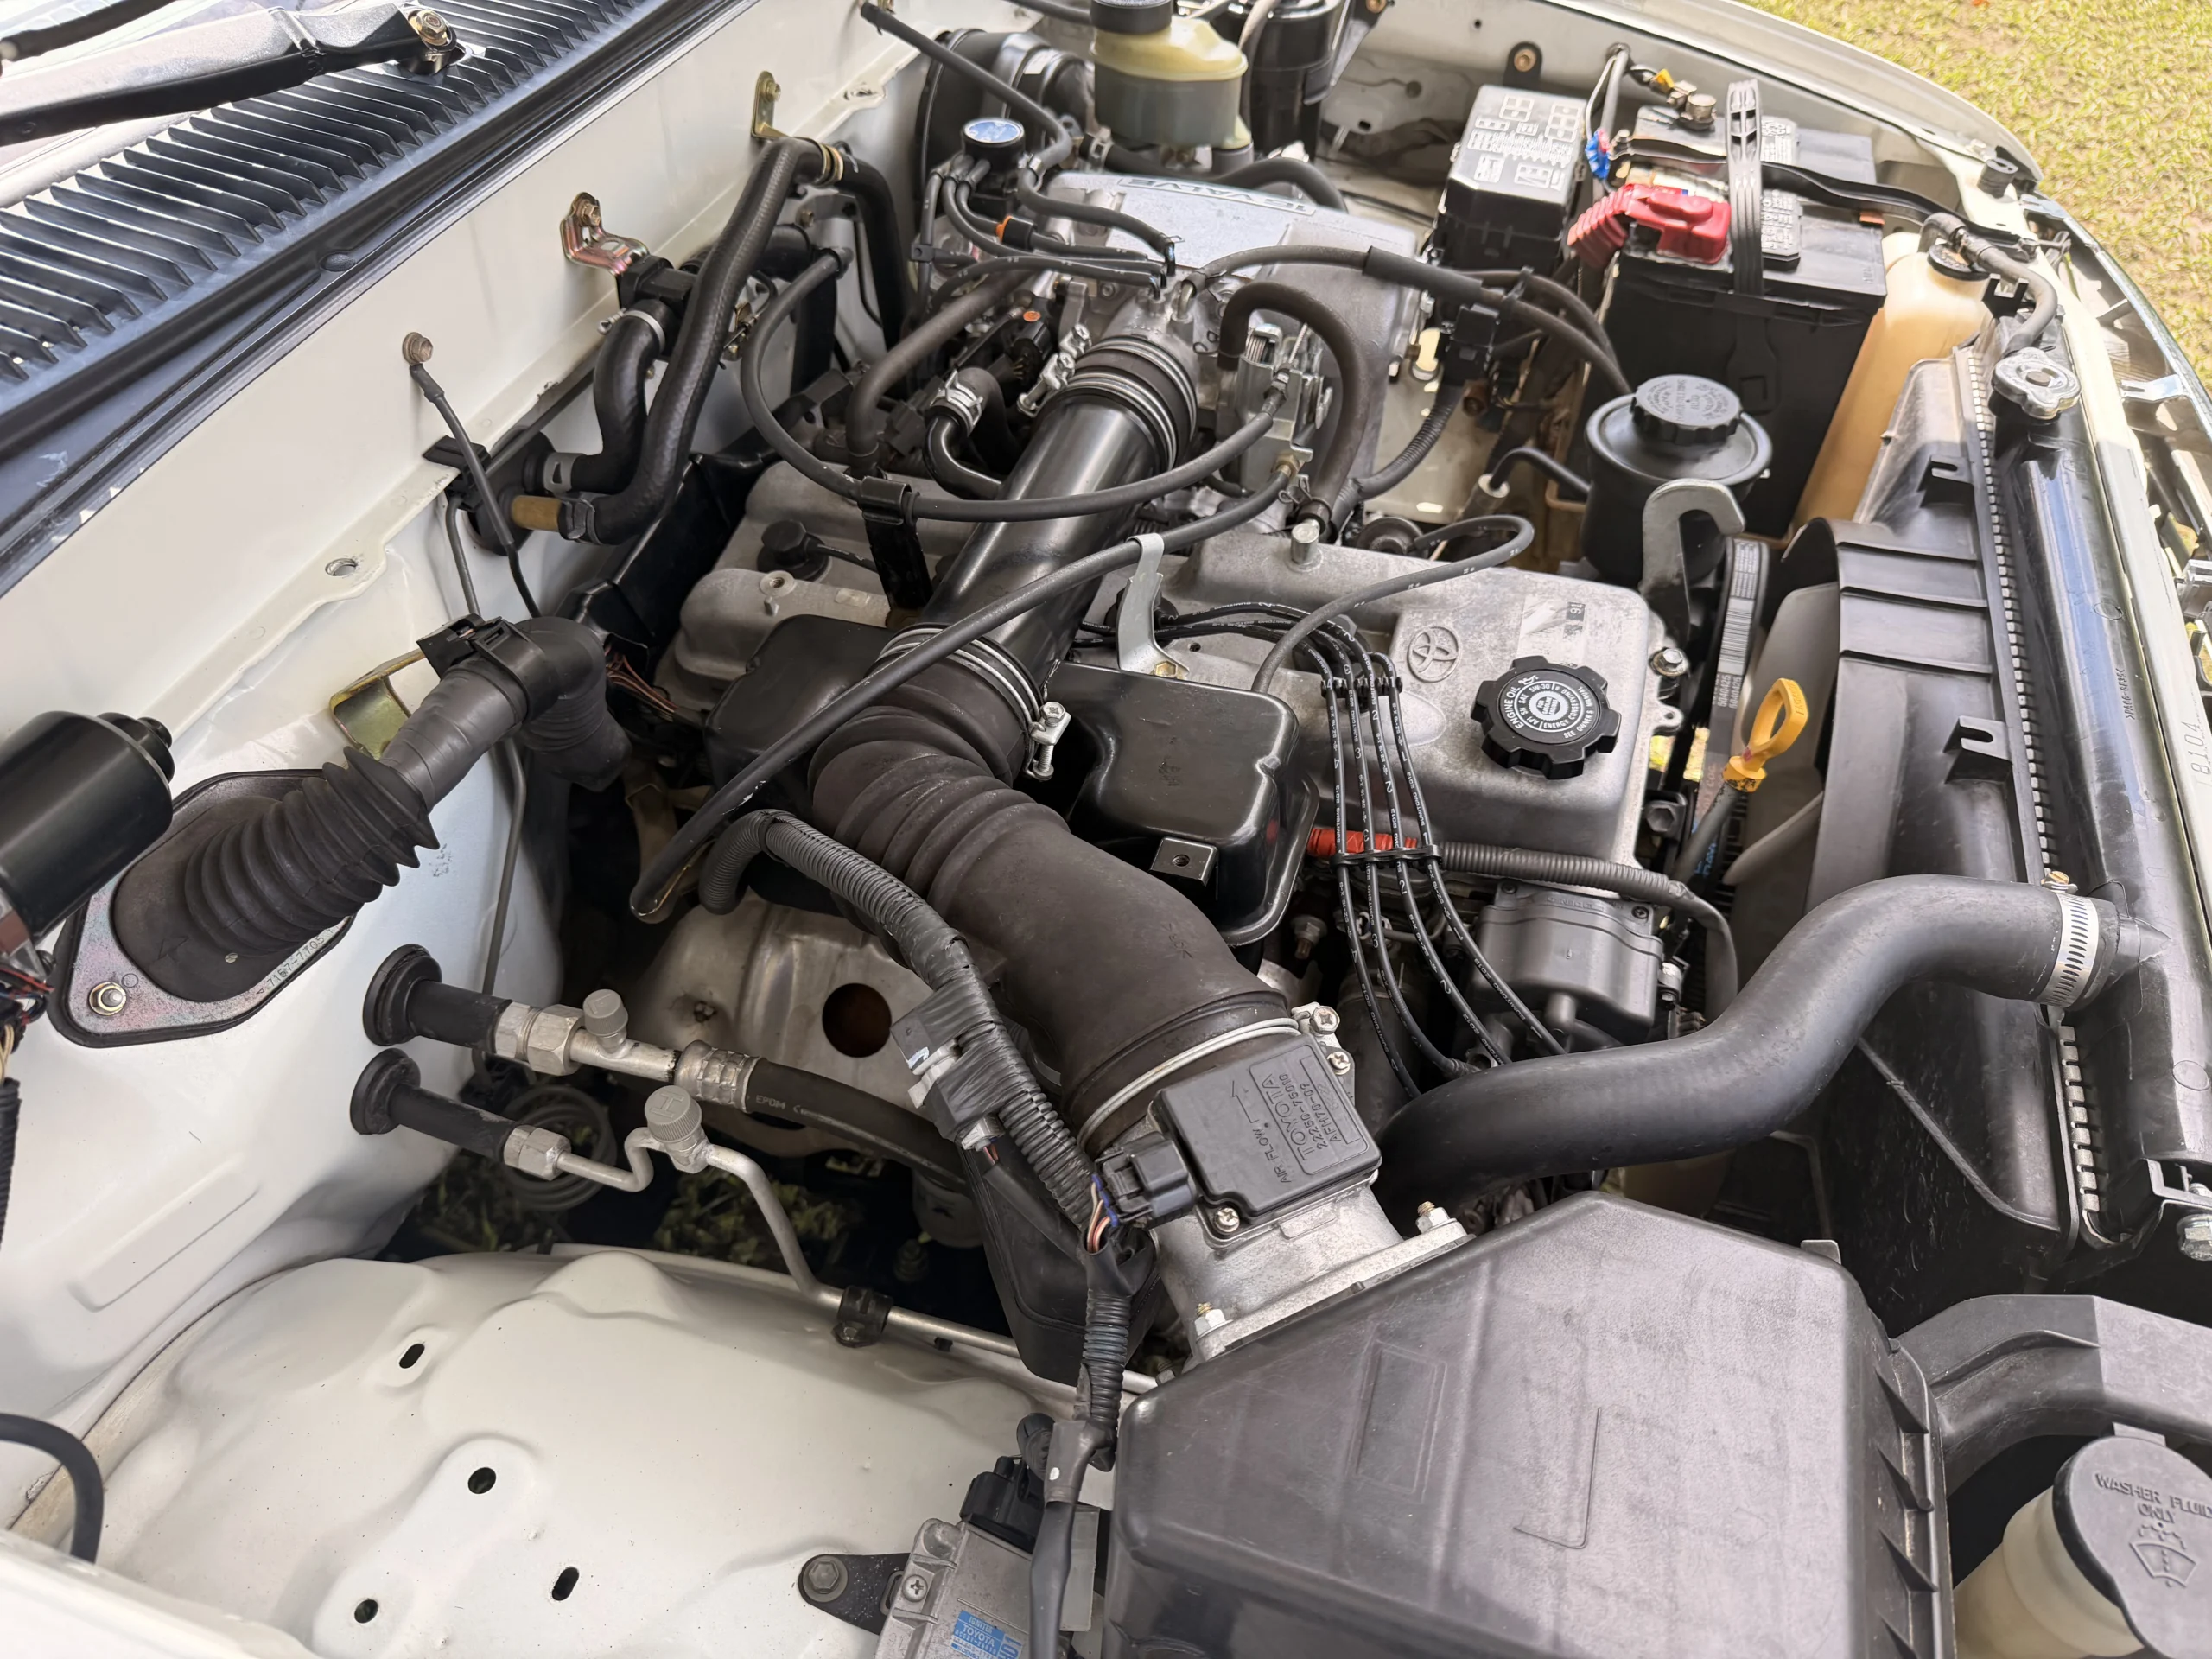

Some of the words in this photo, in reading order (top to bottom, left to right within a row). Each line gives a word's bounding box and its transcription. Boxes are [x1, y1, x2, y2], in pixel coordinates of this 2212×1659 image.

[1128, 178, 1255, 202] VALVE
[1507, 686, 1521, 697] OIL
[1529, 683, 1550, 693] 5W-30
[1518, 693, 1529, 704] SAE
[1371, 709, 1379, 721] 2
[1504, 699, 1524, 729] ENGINE
[1526, 716, 1541, 726] API
[1543, 719, 1568, 729] ENERGY
[1563, 730, 1577, 739] SEE
[1354, 747, 1362, 759] 3
[1334, 759, 1340, 769] 4
[1385, 780, 1393, 793] 2
[1407, 771, 1415, 790] 2013
[1414, 791, 1426, 827] SUMITOMO
[1399, 880, 1407, 894] 2
[1372, 934, 1378, 949] 3
[1351, 949, 1357, 963] 4
[1474, 958, 1492, 980] 2013
[1361, 983, 1371, 1007] 2013
[1440, 979, 1452, 995] 2
[588, 993, 612, 1014] L
[1493, 982, 1526, 1020] SUMITOMO
[1370, 1011, 1389, 1052] SUMITOMO
[1462, 1014, 1479, 1035] 2013
[649, 1091, 690, 1119] H
[1278, 1073, 1329, 1150] 22250-75010
[1260, 1074, 1313, 1161] TOYOTA
[1252, 1128, 1280, 1162] FLOW
[1273, 1164, 1292, 1184] AIR
[2095, 1473, 2161, 1504] WASHER
[2138, 1503, 2175, 1524] ONLY
[969, 1616, 993, 1634] IGNITER
[963, 1624, 995, 1647] TOYOTA
